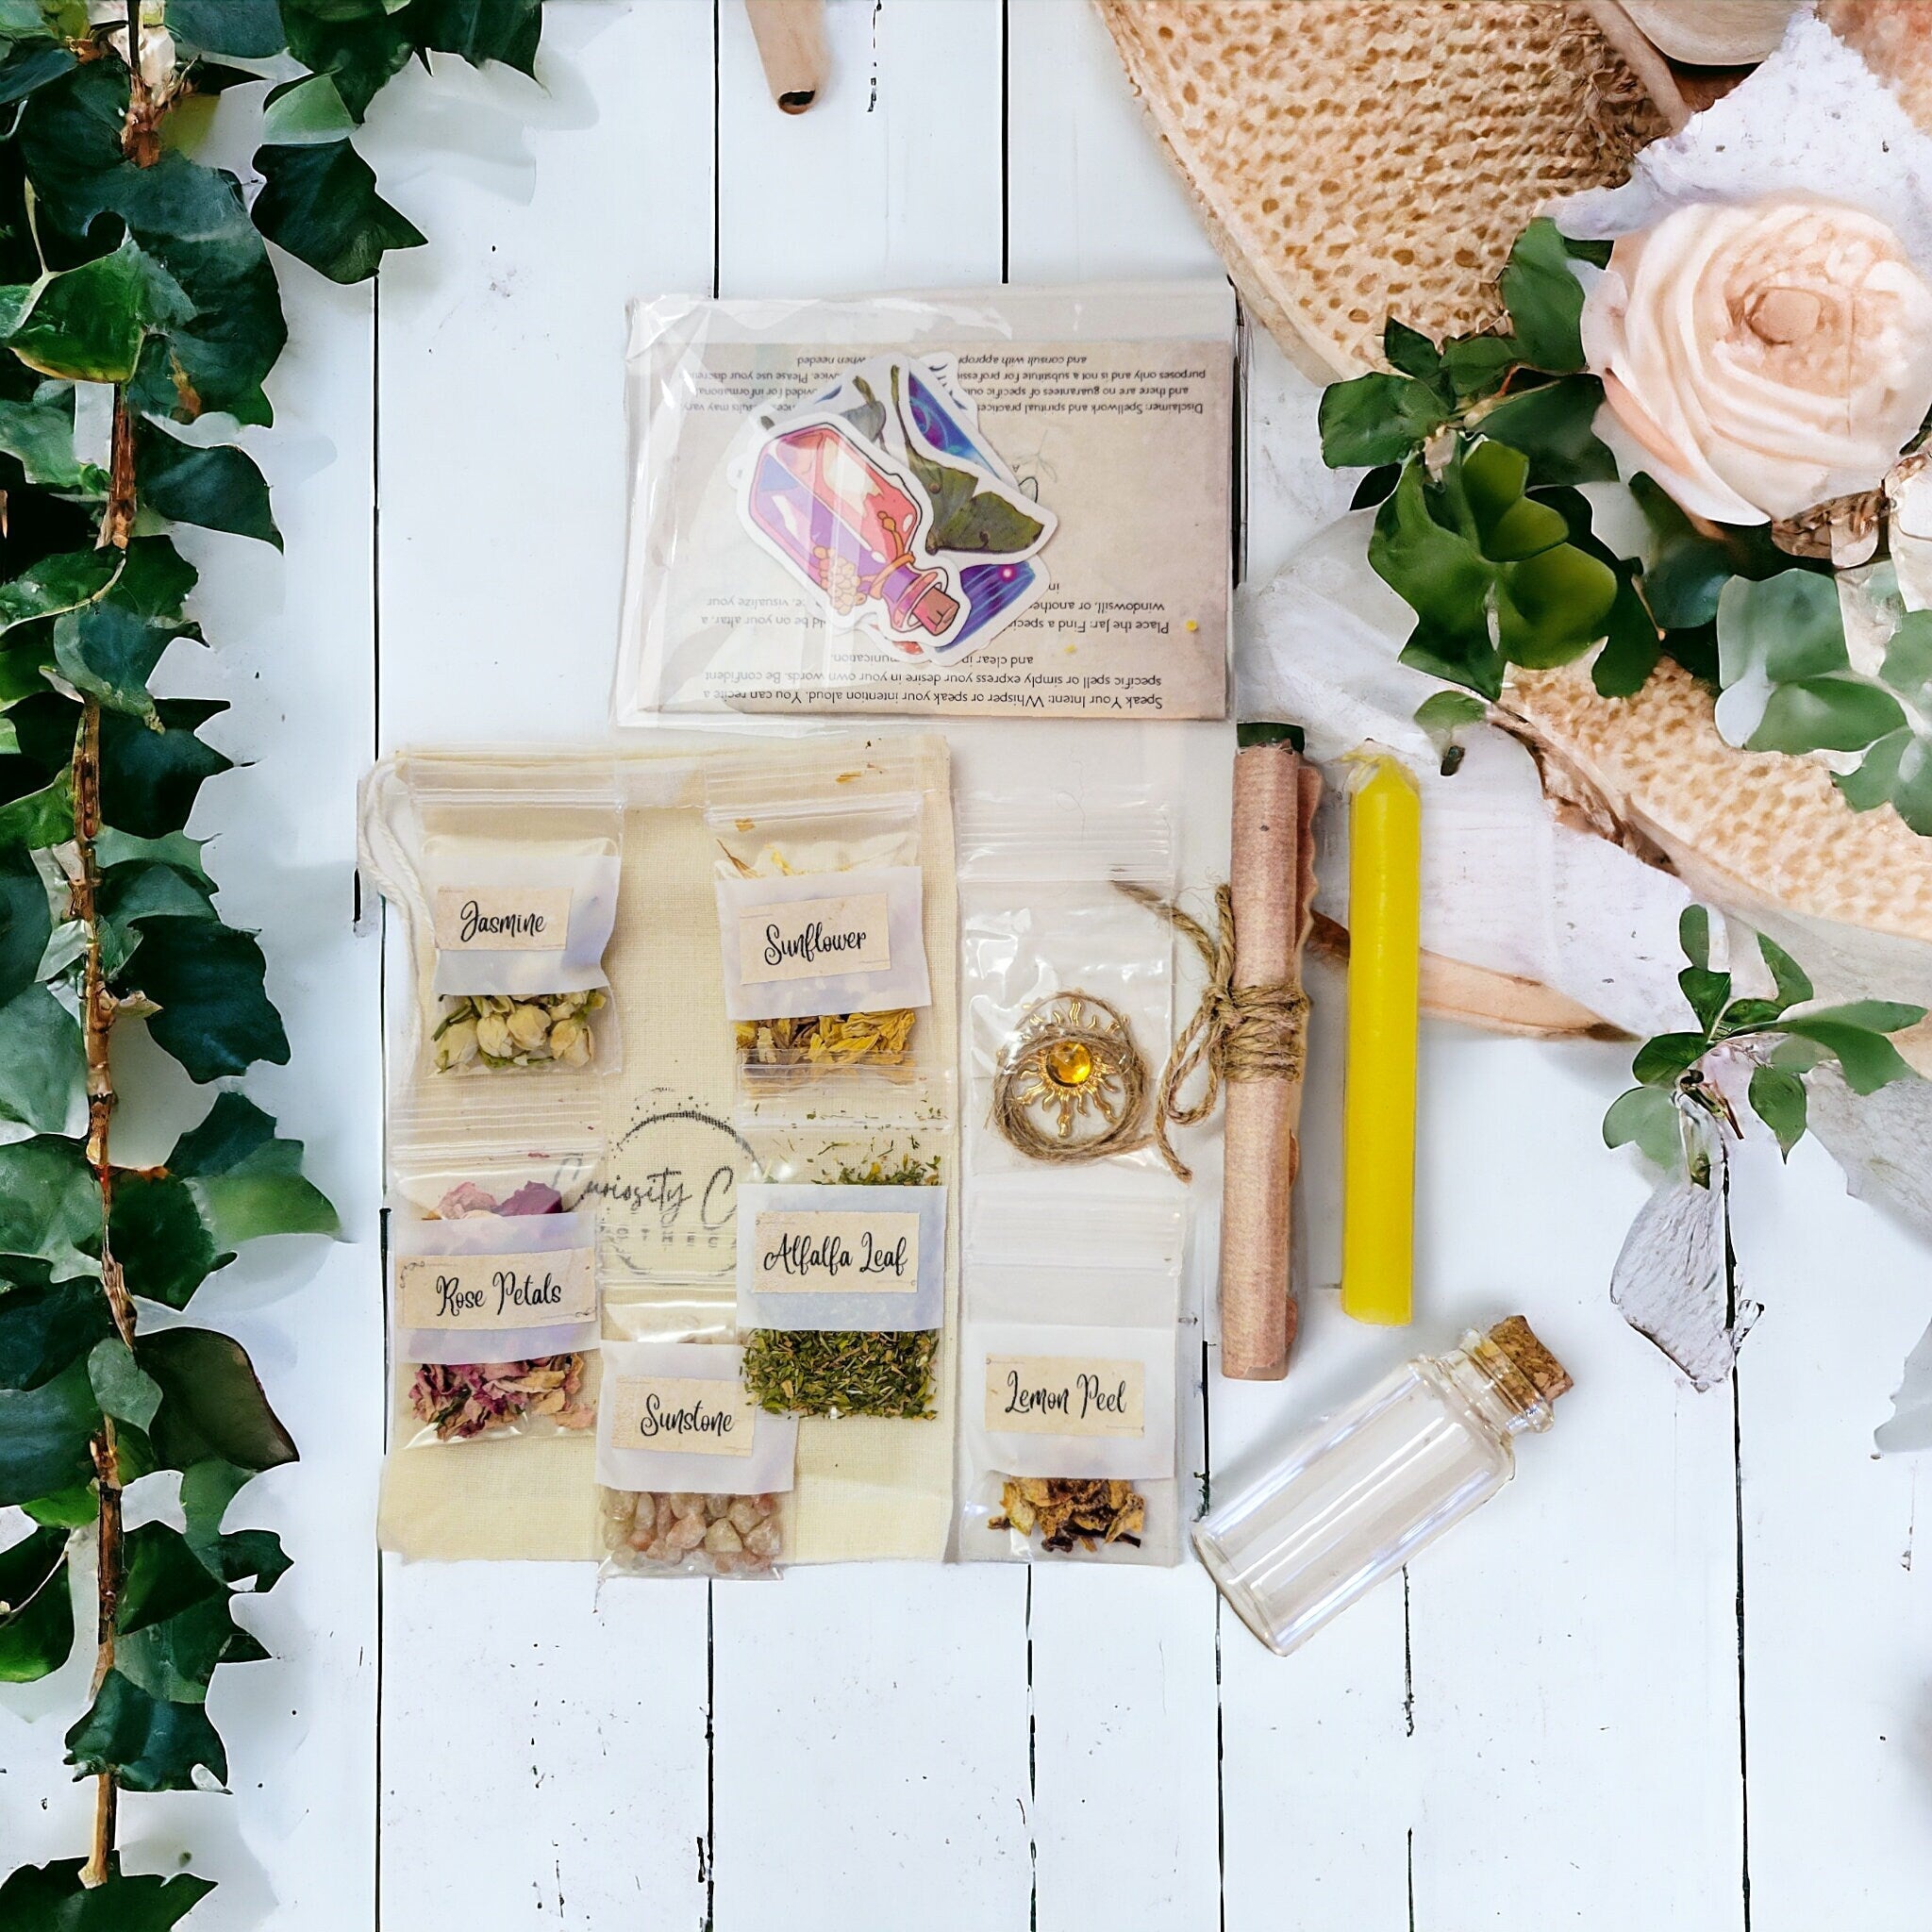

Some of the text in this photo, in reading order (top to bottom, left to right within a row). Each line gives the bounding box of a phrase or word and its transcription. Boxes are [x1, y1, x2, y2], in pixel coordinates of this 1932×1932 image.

[1002, 356, 1024, 365] with
[1027, 356, 1064, 366] consult
[1067, 356, 1087, 366] and
[730, 370, 754, 380] your
[757, 372, 773, 380] use
[775, 372, 808, 381] Please
[1004, 373, 1020, 382] for
[1023, 372, 1070, 381] substitute
[1073, 372, 1079, 380] a
[1082, 372, 1098, 381] not
[1101, 372, 1108, 380] is
[1111, 372, 1131, 382] and
[1134, 370, 1157, 381] only
[1159, 370, 1205, 380] purposes
[765, 388, 782, 398] for
[987, 385, 1026, 397] specific
[1028, 388, 1040, 398] of
[1042, 385, 1100, 396] guarantees
[1140, 388, 1166, 397] there
[1169, 388, 1188, 397] and
[708, 402, 728, 410] may
[1024, 402, 1065, 414] spiritual
[1069, 404, 1088, 413] and
[1091, 402, 1142, 414] Spellwork
[1145, 403, 1203, 414] Disclaimer:
[708, 597, 735, 608] your
[739, 598, 789, 609] visualize
[1094, 602, 1164, 613] windowsill,
[744, 614, 772, 625] your
[776, 617, 790, 625] on
[1002, 619, 1043, 631] speci
[1058, 621, 1086, 632] Find
[1090, 619, 1109, 632] Jar:
[1112, 621, 1131, 632] the
[1136, 621, 1169, 633] Place
[976, 656, 1007, 667] clear
[1010, 657, 1033, 667] and
[706, 672, 1161, 689] specific spell or simply express your desire in your own words. Be confident
[714, 691, 746, 701] recite
[775, 691, 801, 703] You
[806, 691, 842, 703] aloud.
[846, 691, 898, 703] intention
[903, 691, 930, 702] your
[933, 692, 967, 707] speak
[972, 694, 984, 703] or
[990, 692, 1044, 708] Whisper
[1048, 695, 1086, 708] Intent:
[1091, 695, 1122, 708] Your
[1125, 695, 1162, 709] Speak
[460, 900, 547, 942] Jasmine
[764, 921, 866, 966] Sunflower
[763, 1231, 908, 1276] Alfalfa Leaf
[436, 1271, 562, 1317] Rose Petals
[1005, 1370, 1126, 1419] Lemon Peel
[640, 1392, 734, 1437] Sunstone
